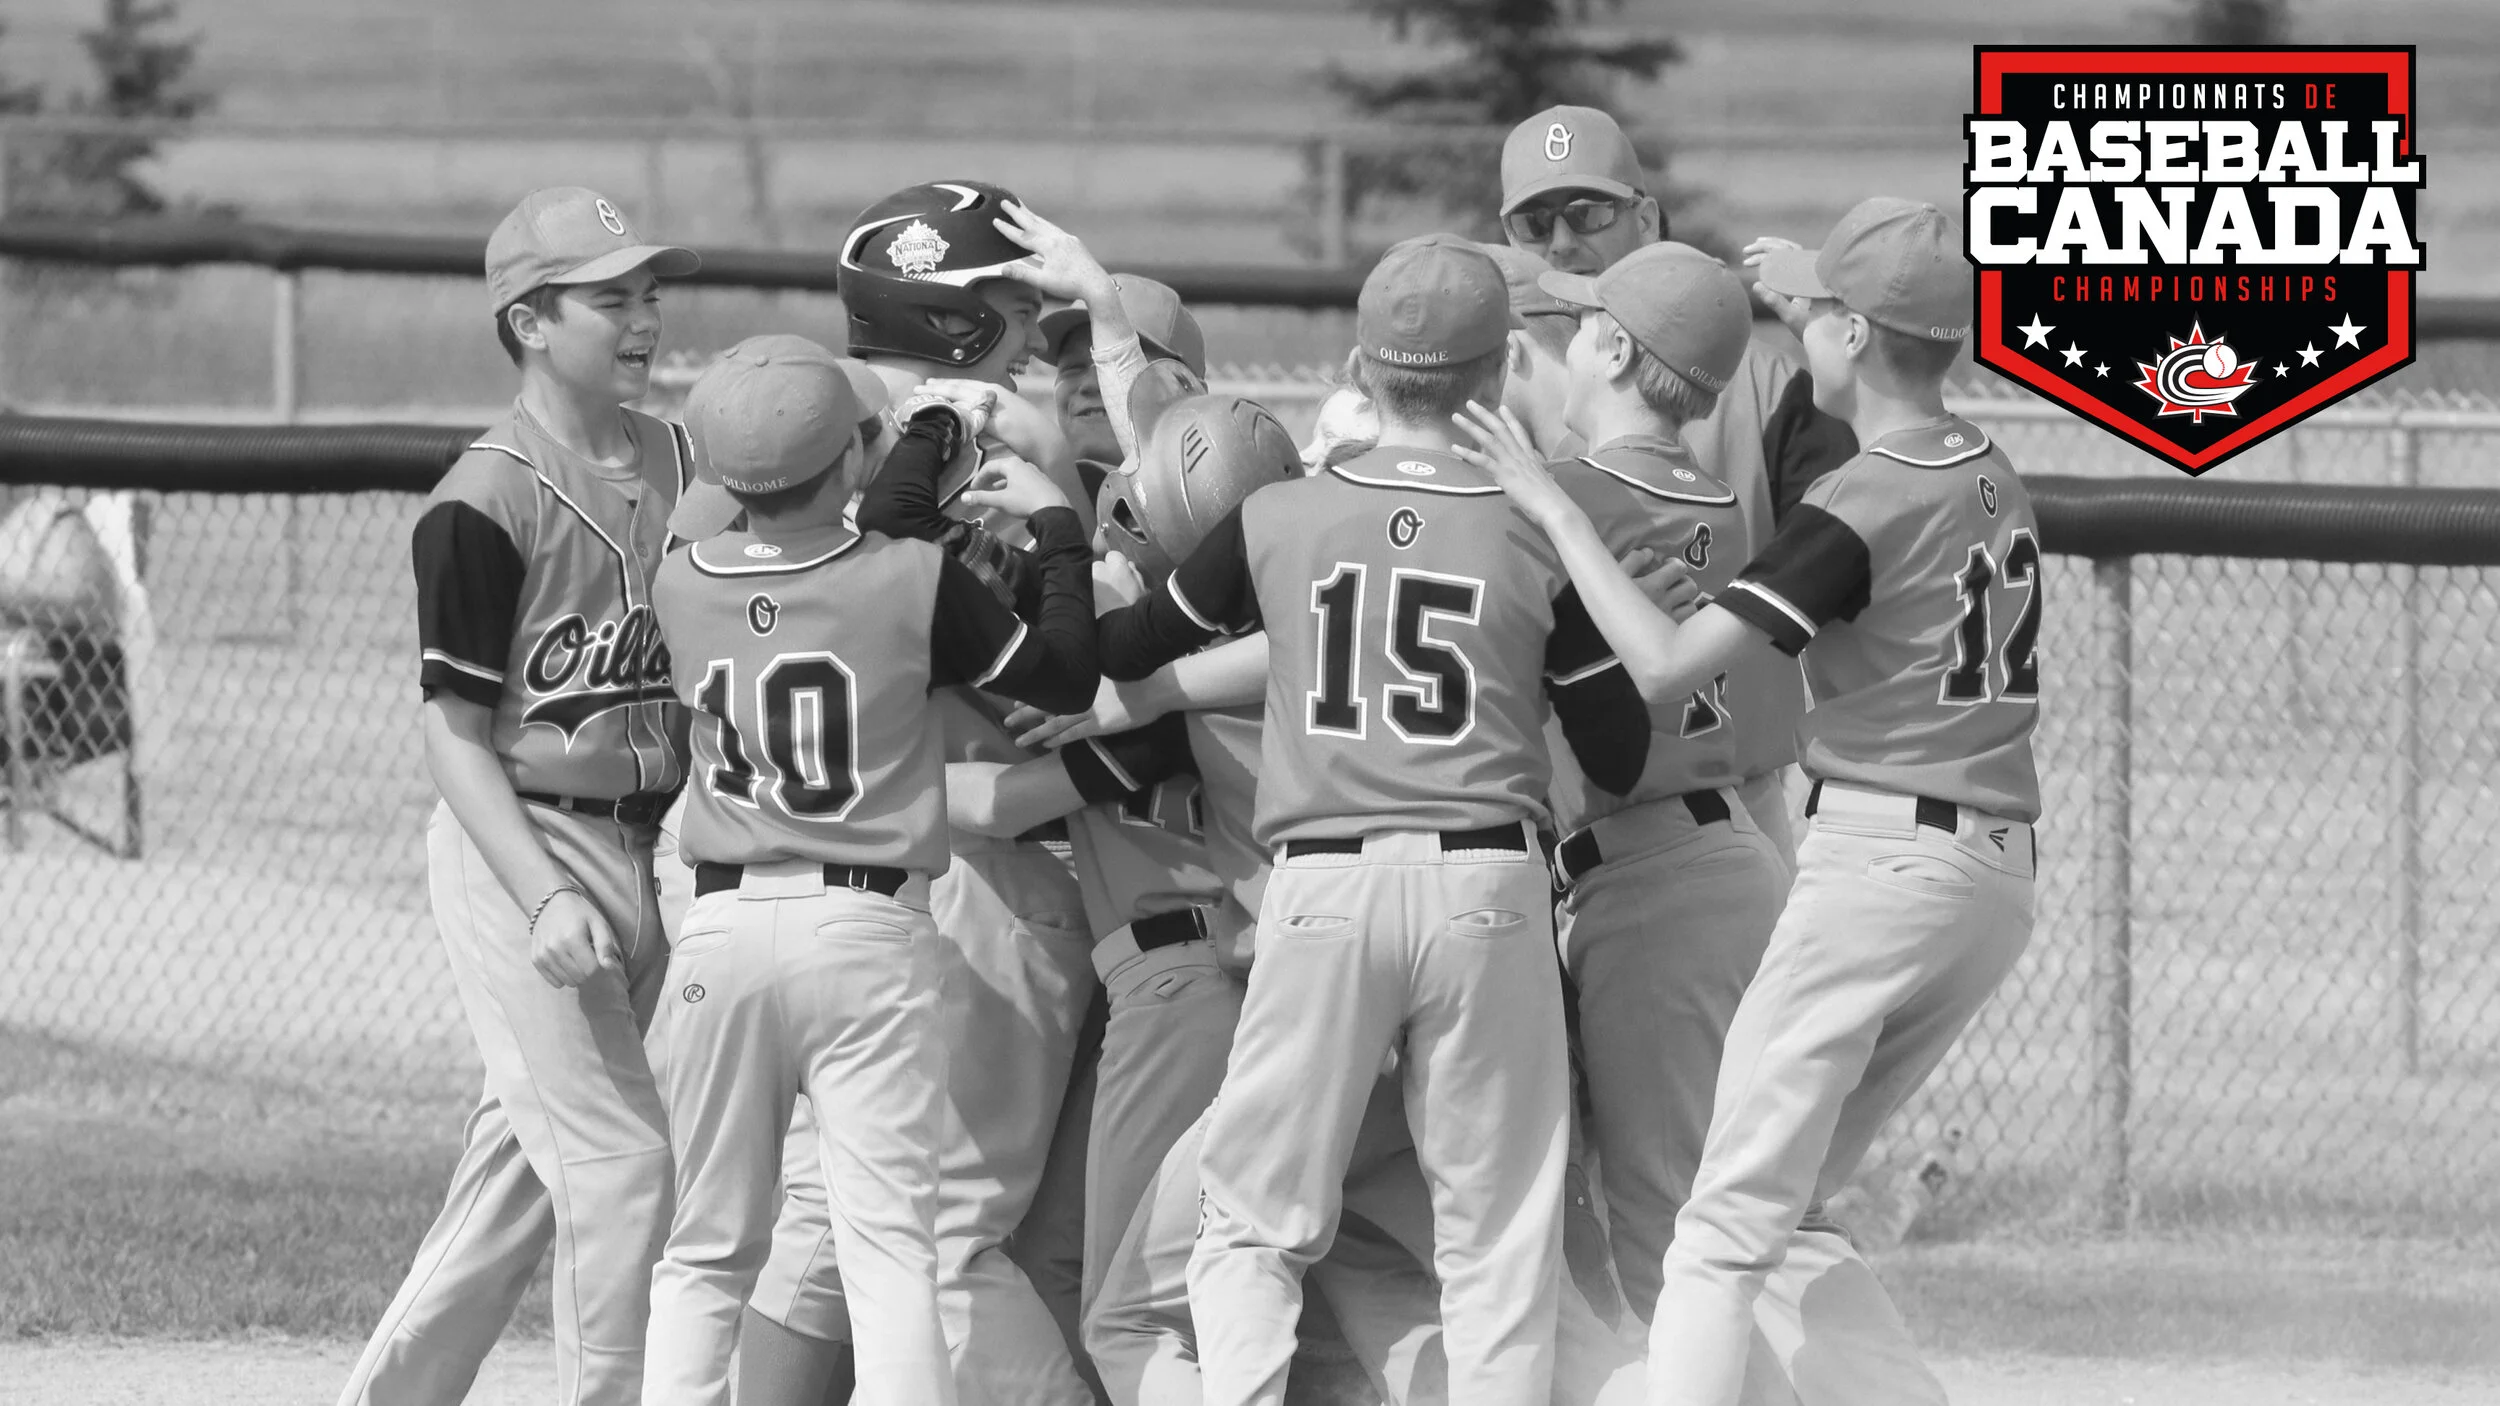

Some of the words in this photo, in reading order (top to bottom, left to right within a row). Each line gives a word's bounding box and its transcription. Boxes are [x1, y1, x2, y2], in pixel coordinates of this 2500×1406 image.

[895, 240, 942, 256] NATIONAL
[1380, 347, 1449, 364] OILDOME
[722, 475, 789, 492] OILDOME
[1306, 561, 1486, 746] 15
[1937, 527, 2043, 707] 12
[694, 650, 864, 822] 10
